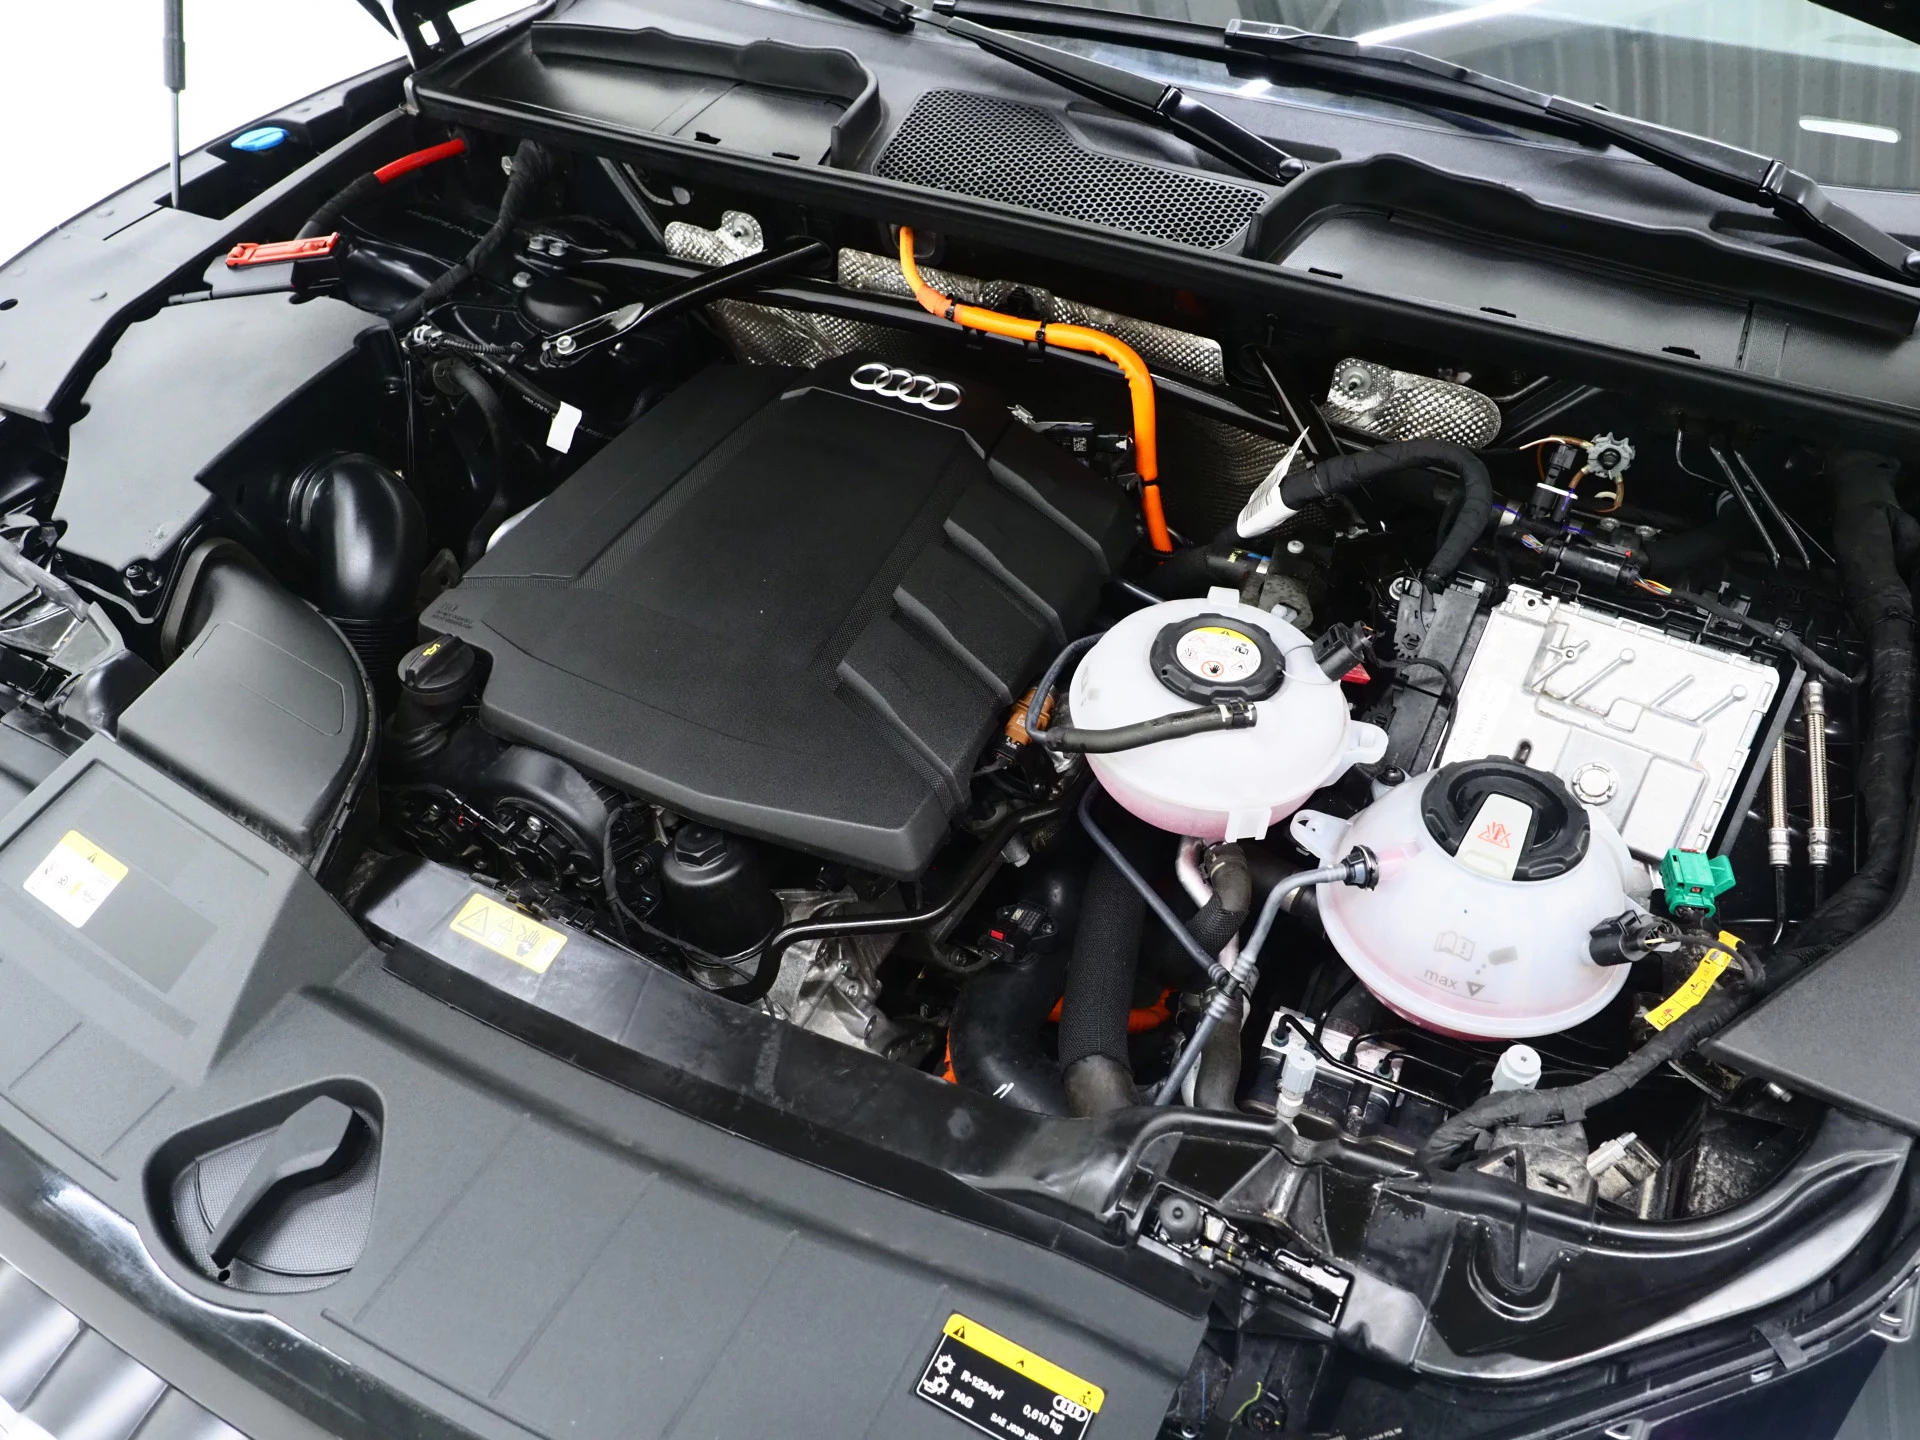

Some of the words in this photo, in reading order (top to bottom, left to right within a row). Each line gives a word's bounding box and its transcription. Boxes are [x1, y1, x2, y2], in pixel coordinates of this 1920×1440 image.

[1424, 969, 1457, 990] max
[950, 1388, 975, 1409] PAG
[989, 1412, 1008, 1428] SAE
[1022, 1404, 1050, 1426] 0,610
[1049, 1418, 1064, 1435] kg
